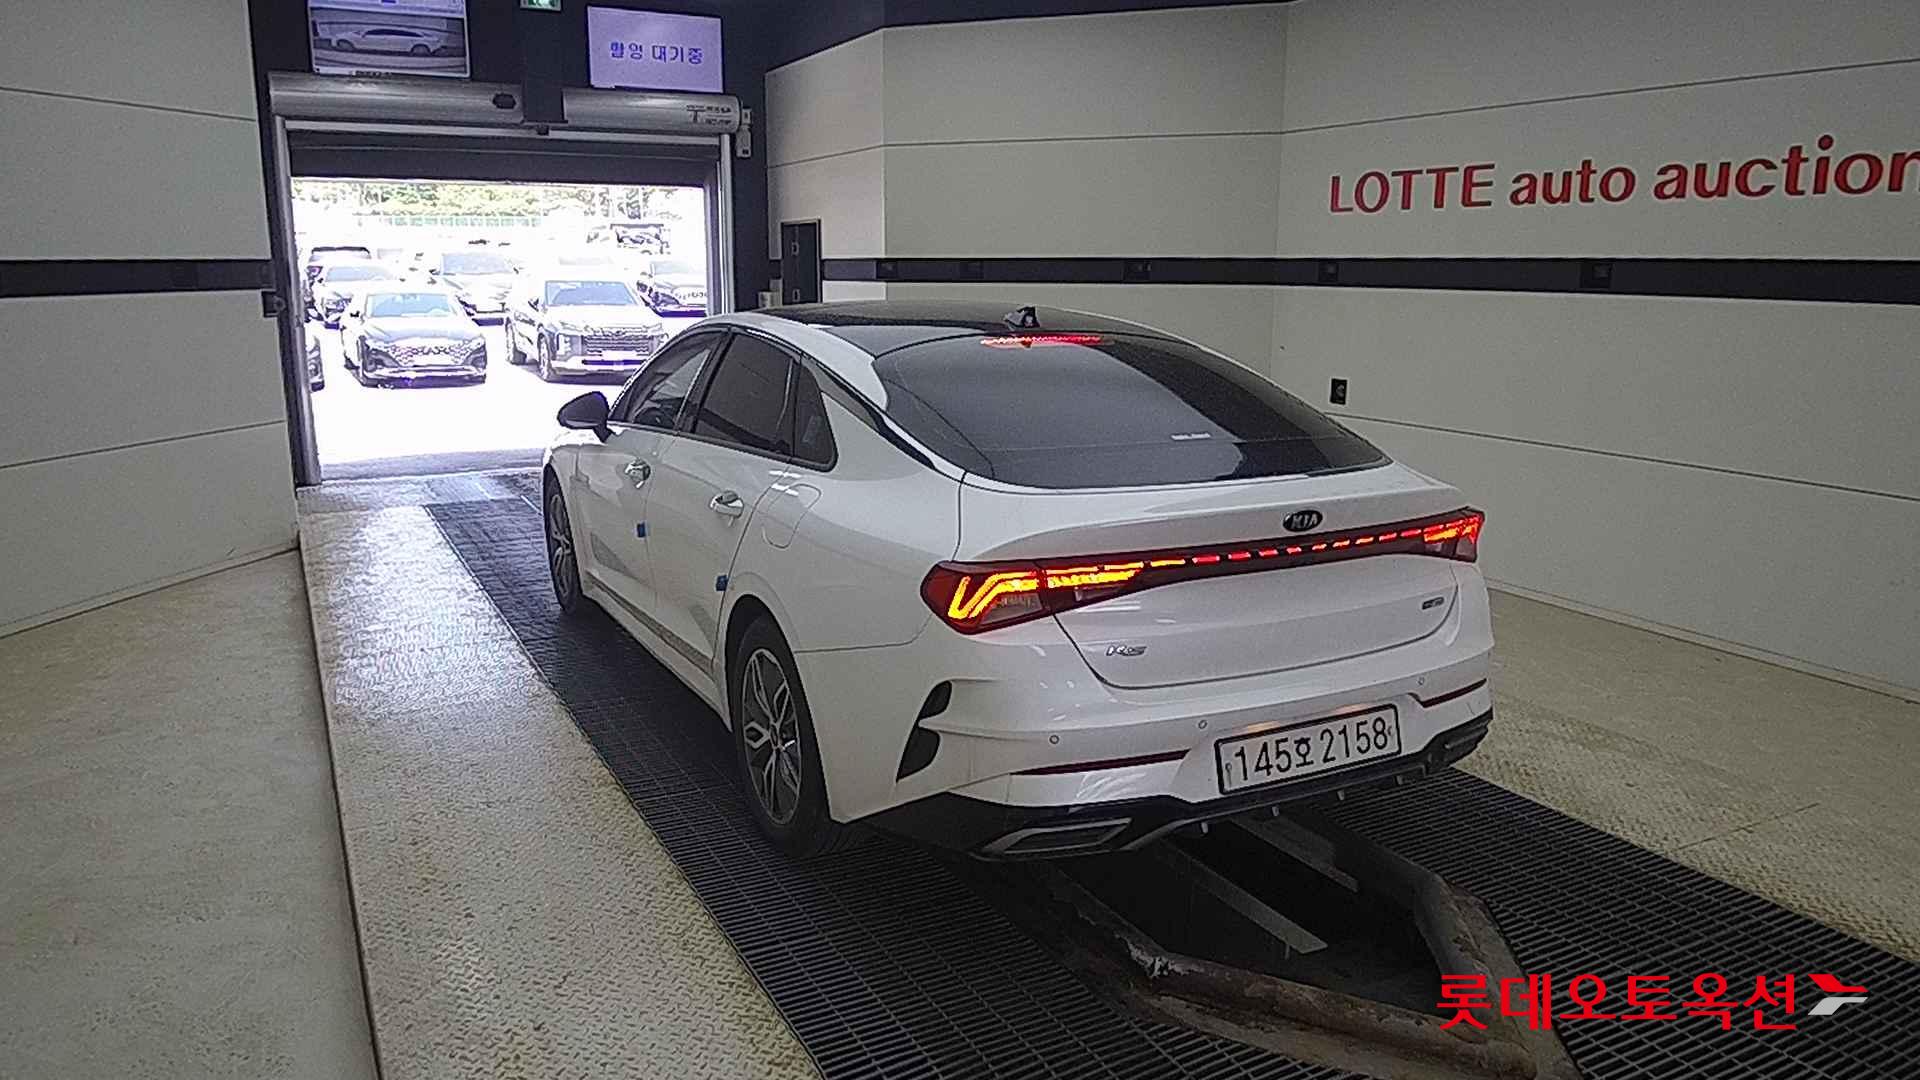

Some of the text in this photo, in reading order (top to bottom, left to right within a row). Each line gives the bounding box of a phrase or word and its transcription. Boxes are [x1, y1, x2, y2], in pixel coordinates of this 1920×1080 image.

[651, 44, 703, 65] 대기중
[1329, 163, 1495, 213] LOTTE
[1508, 158, 1637, 206] auto
[1288, 512, 1319, 529] KIA
[1234, 716, 1388, 781] 145호 2158
